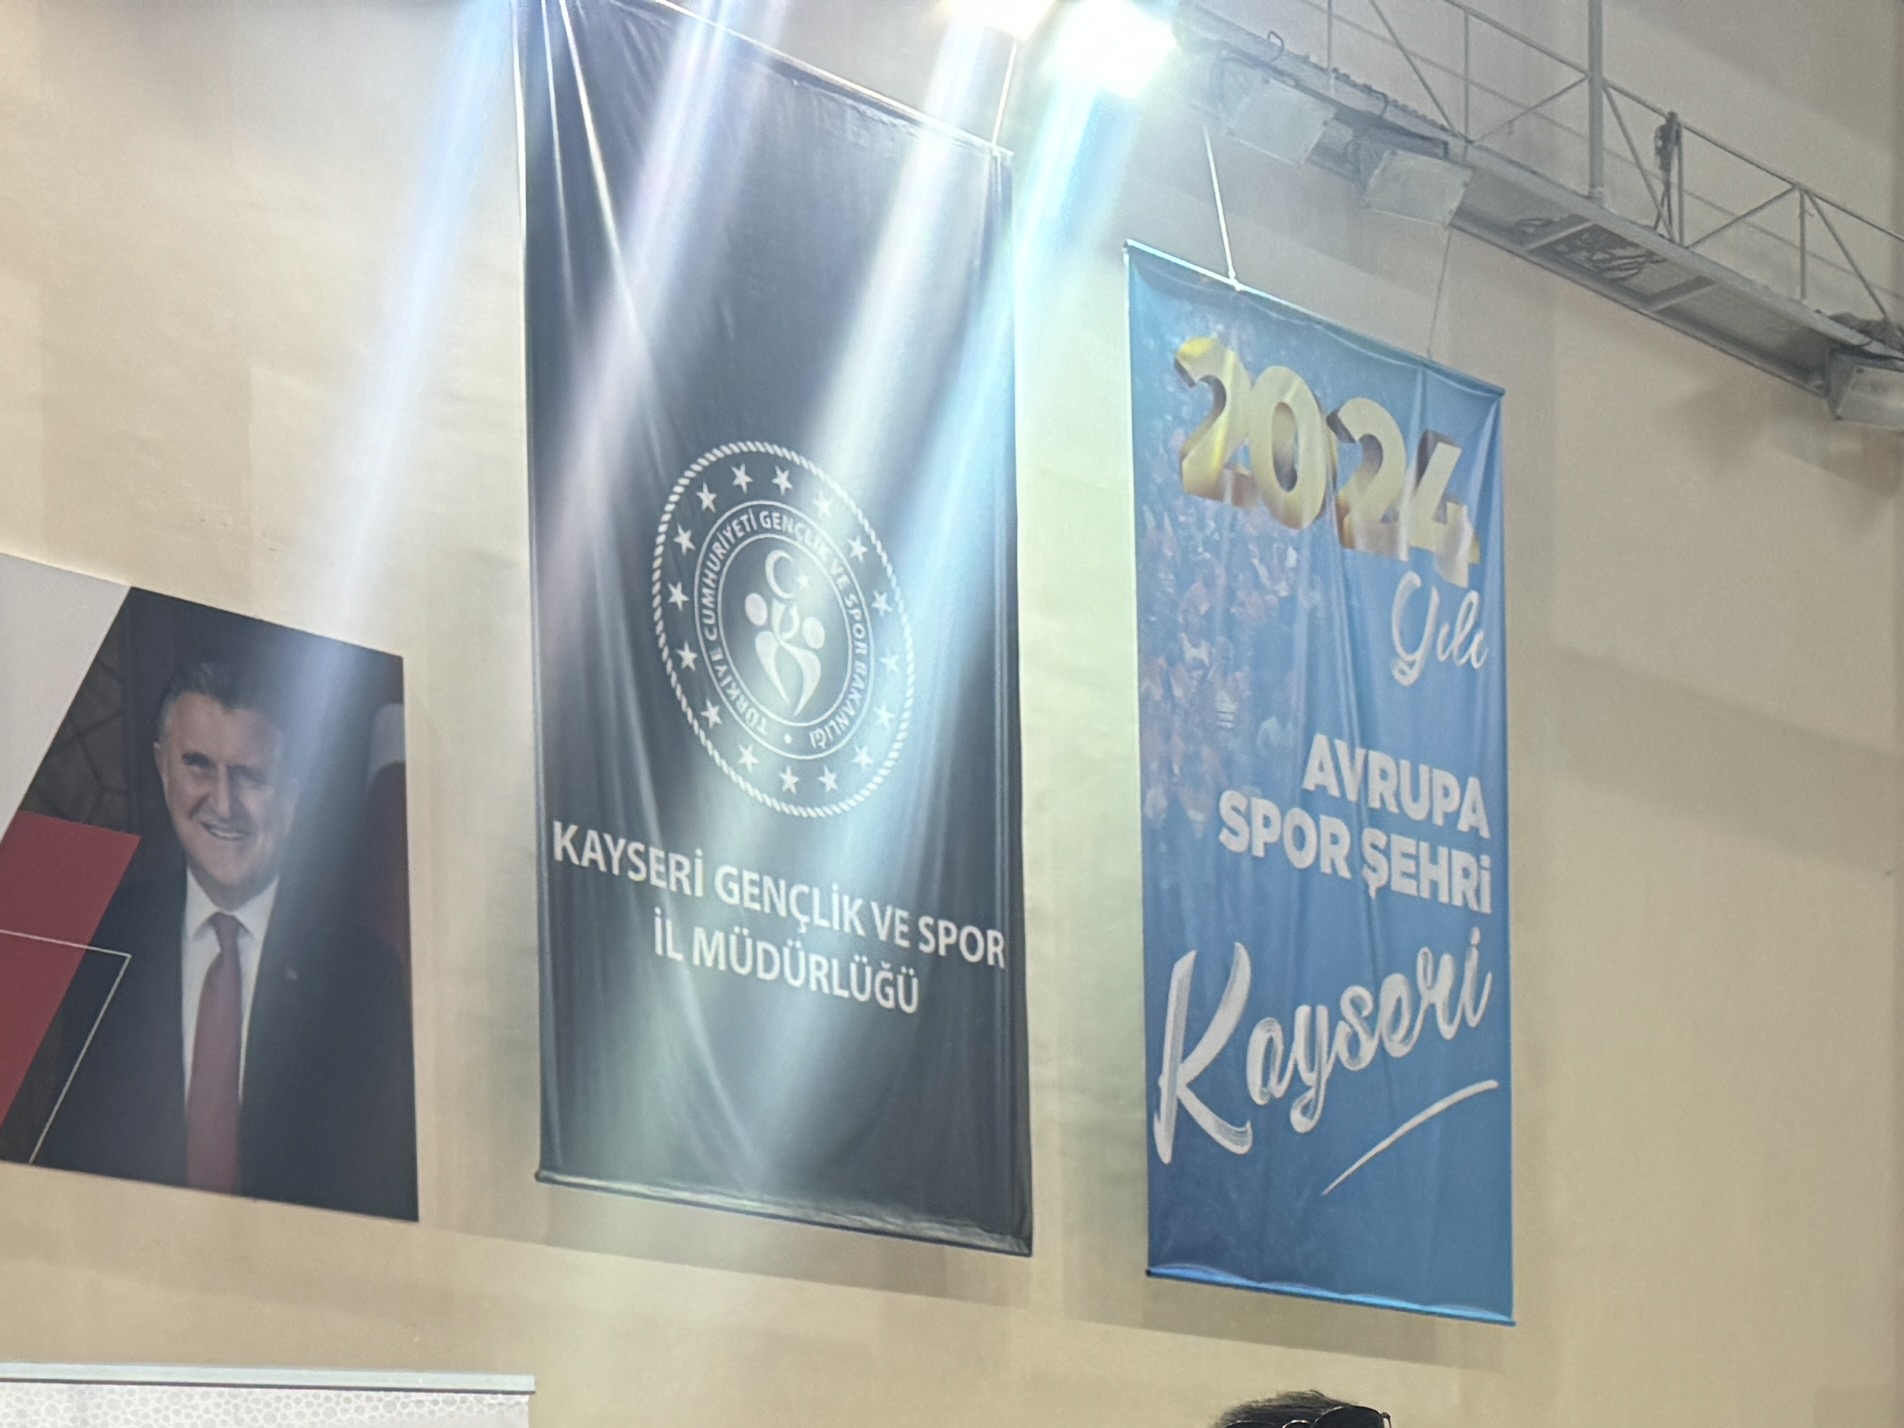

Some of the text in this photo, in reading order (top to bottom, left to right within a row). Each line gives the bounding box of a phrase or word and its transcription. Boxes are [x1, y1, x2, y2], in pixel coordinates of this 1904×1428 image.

[1174, 336, 1481, 589] 2024
[1218, 789, 1352, 879] SPOR
[1303, 733, 1491, 839] AVRUPA
[552, 820, 1006, 969] KAYSERİ GENÇLİK VE SPOR
[653, 907, 920, 1015] İL MÜDÜRLÜĞÜ
[1154, 927, 1492, 1165] Kayseri
